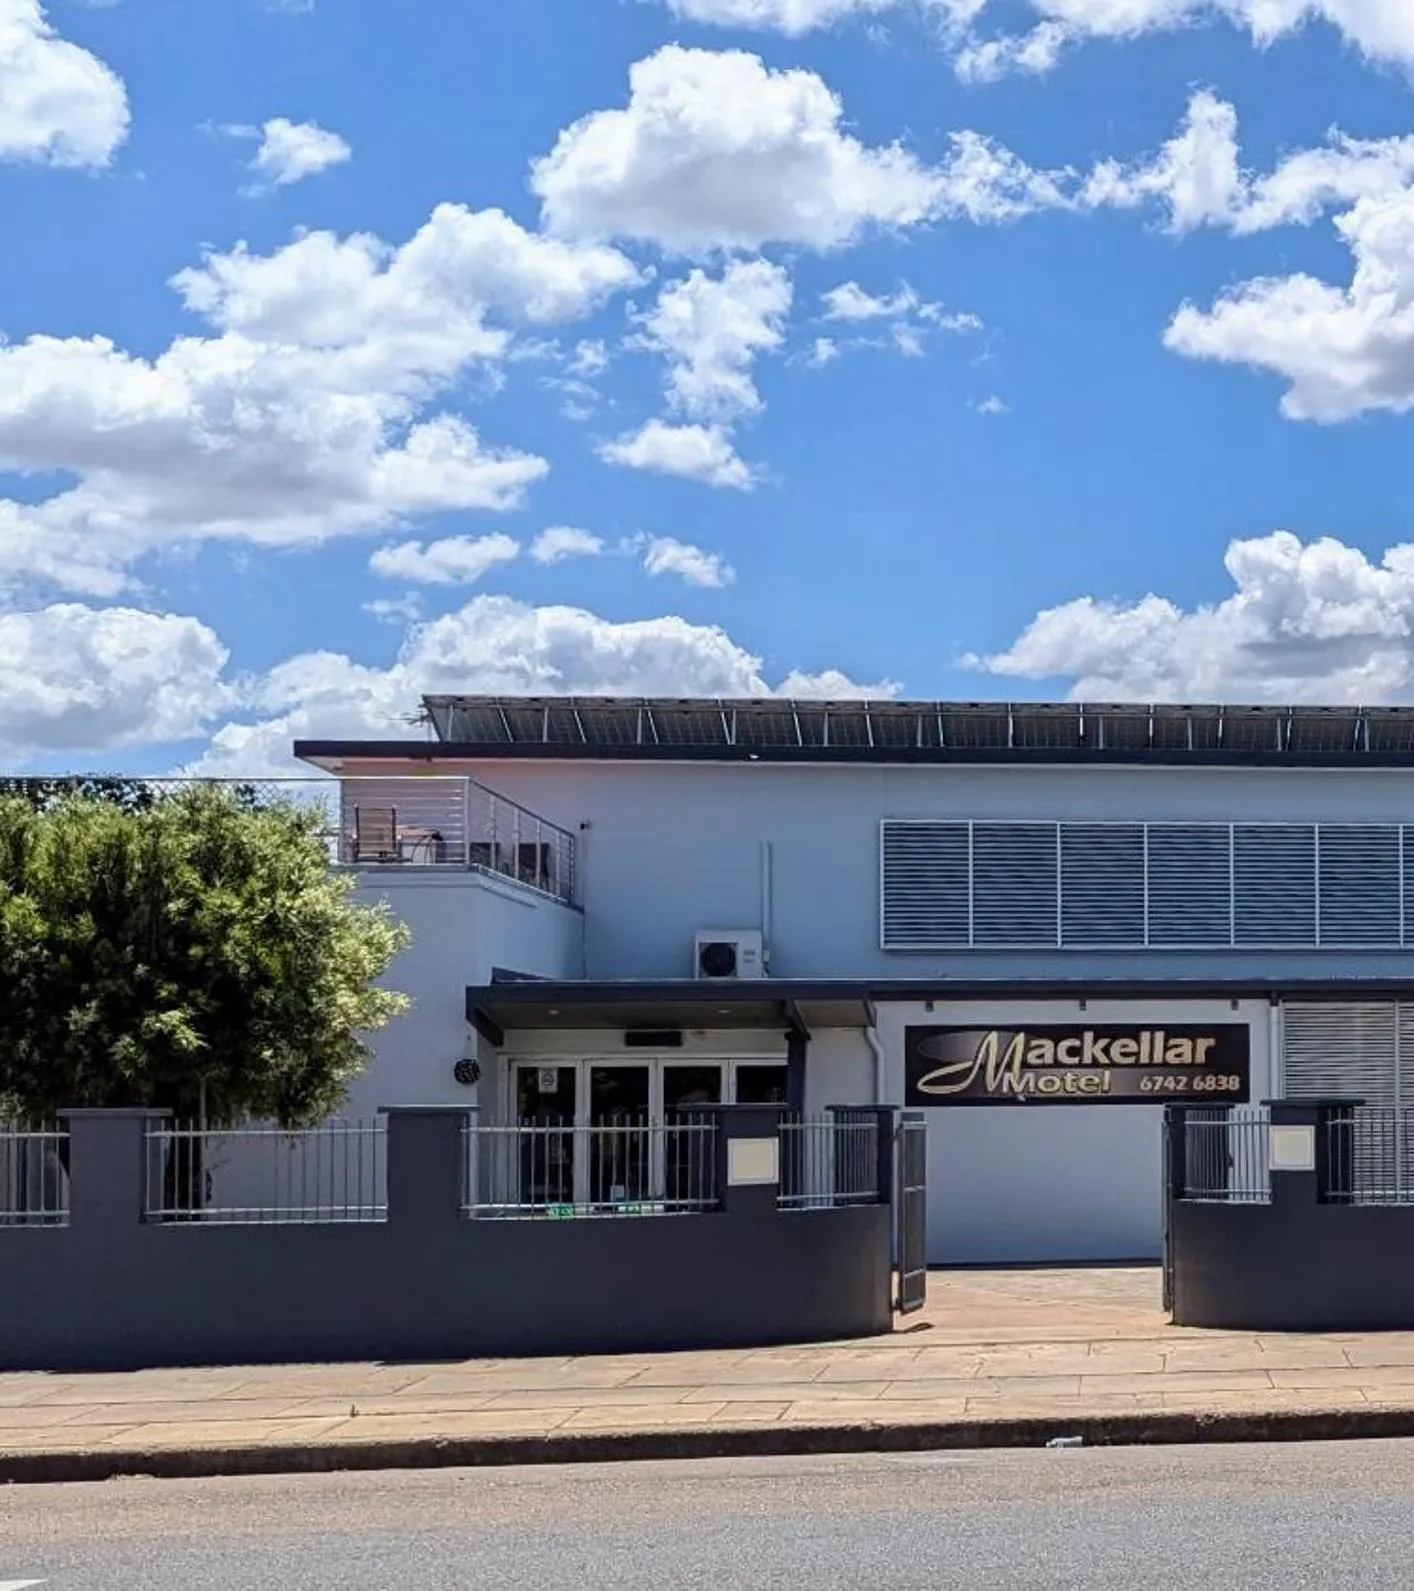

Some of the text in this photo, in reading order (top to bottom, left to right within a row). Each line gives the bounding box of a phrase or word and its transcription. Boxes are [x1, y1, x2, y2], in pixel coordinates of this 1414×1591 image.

[917, 1030, 1217, 1101] Mackellar
[1002, 1070, 1241, 1094] Motel 6742 6838
